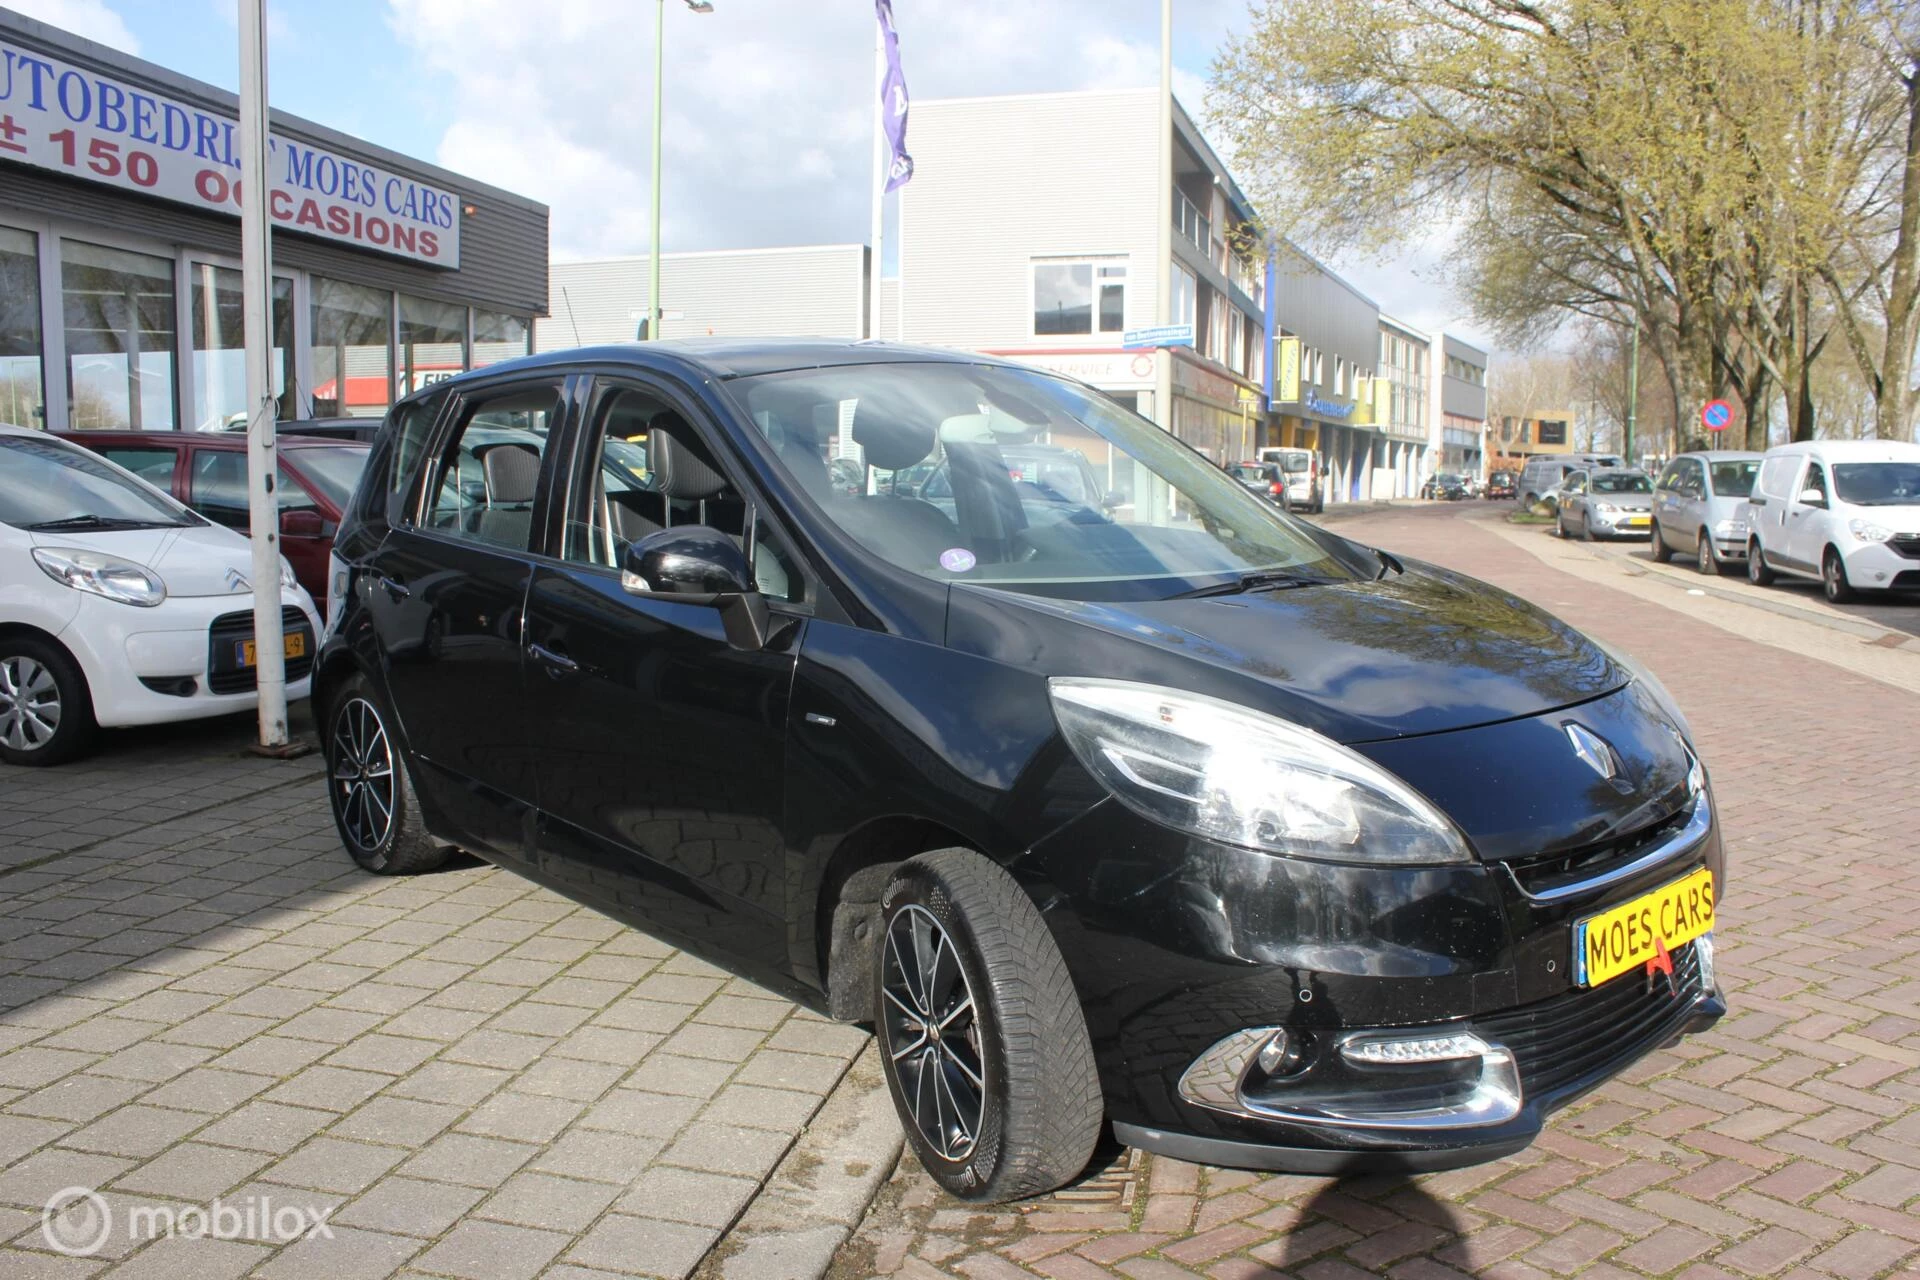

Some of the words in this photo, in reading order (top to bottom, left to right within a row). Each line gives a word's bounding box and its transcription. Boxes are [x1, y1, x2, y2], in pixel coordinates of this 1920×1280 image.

[48, 128, 159, 188] 150
[194, 169, 439, 257] OCASIONS
[285, 144, 376, 208] MOES
[384, 178, 453, 230] CARS
[1590, 909, 1652, 974] MOES
[1660, 883, 1713, 940] CARS
